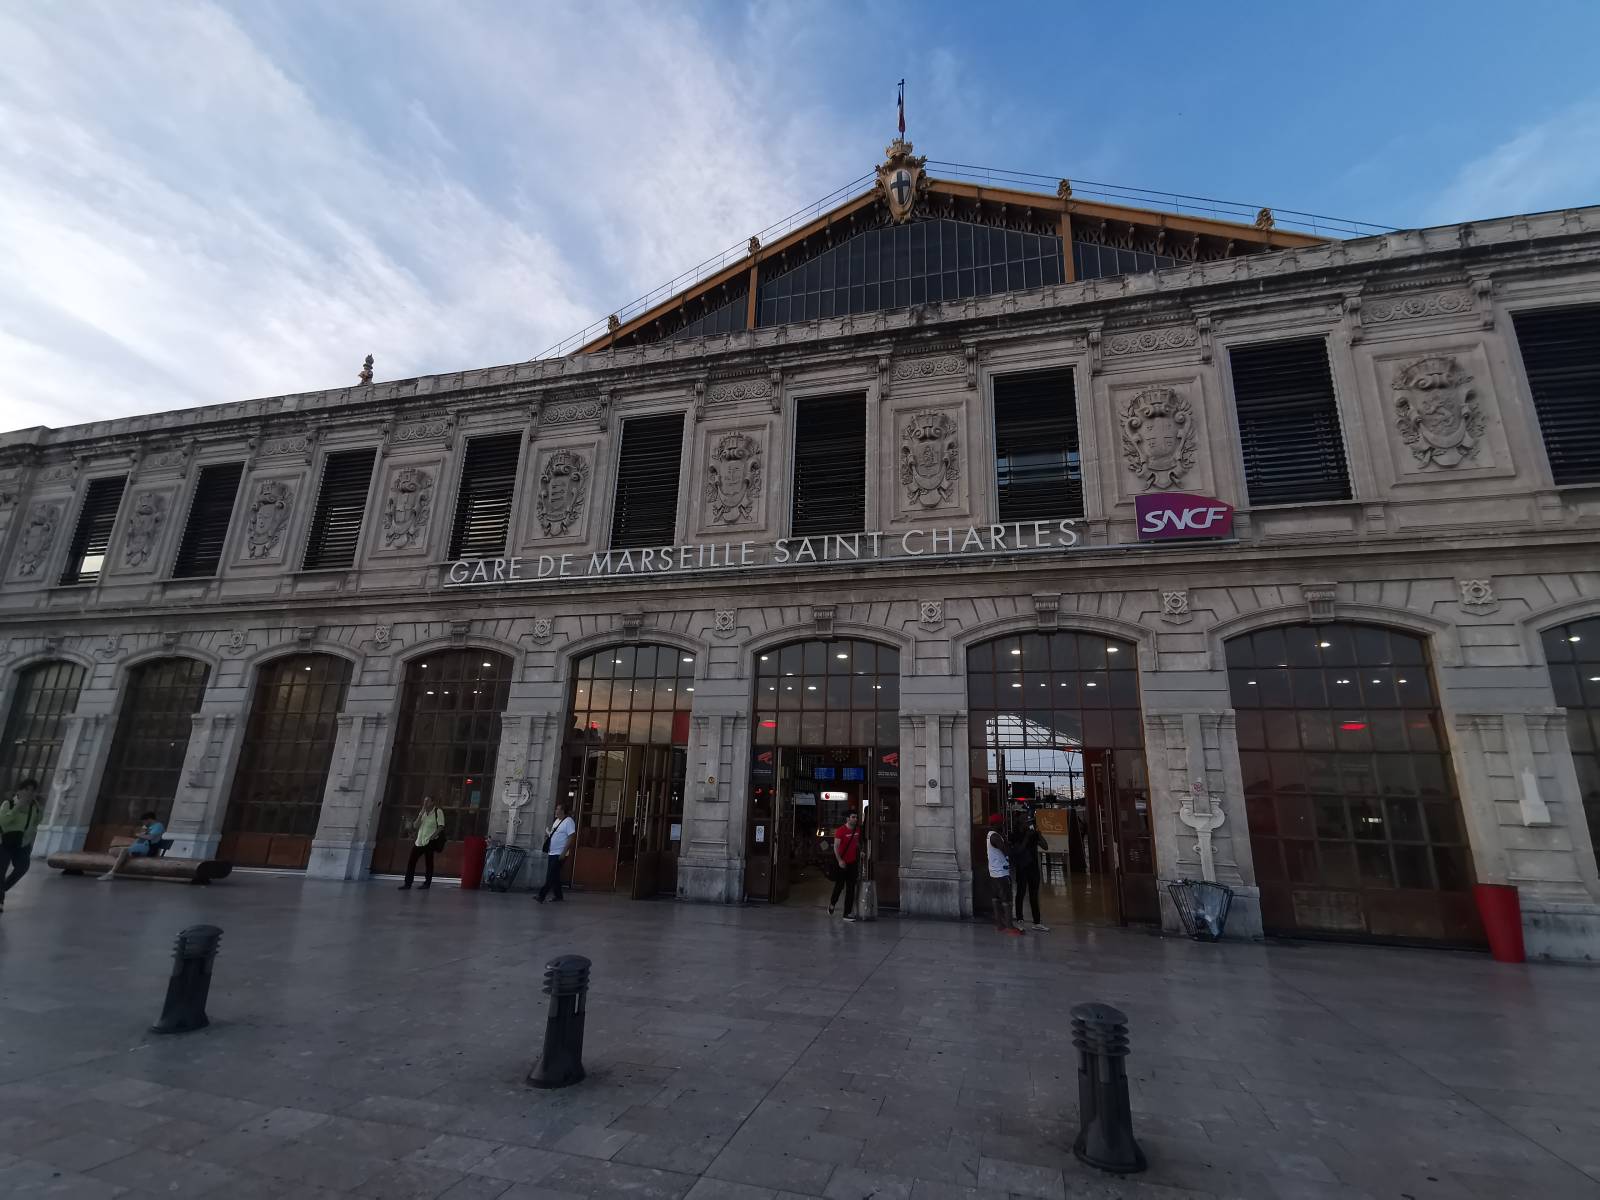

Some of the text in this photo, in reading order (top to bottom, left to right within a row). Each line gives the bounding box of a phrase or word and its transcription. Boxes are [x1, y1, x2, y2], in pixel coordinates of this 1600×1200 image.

[1141, 506, 1228, 533] SNCF
[450, 519, 1078, 583] GARE DE MARSEILLE SAINT CHARLES
